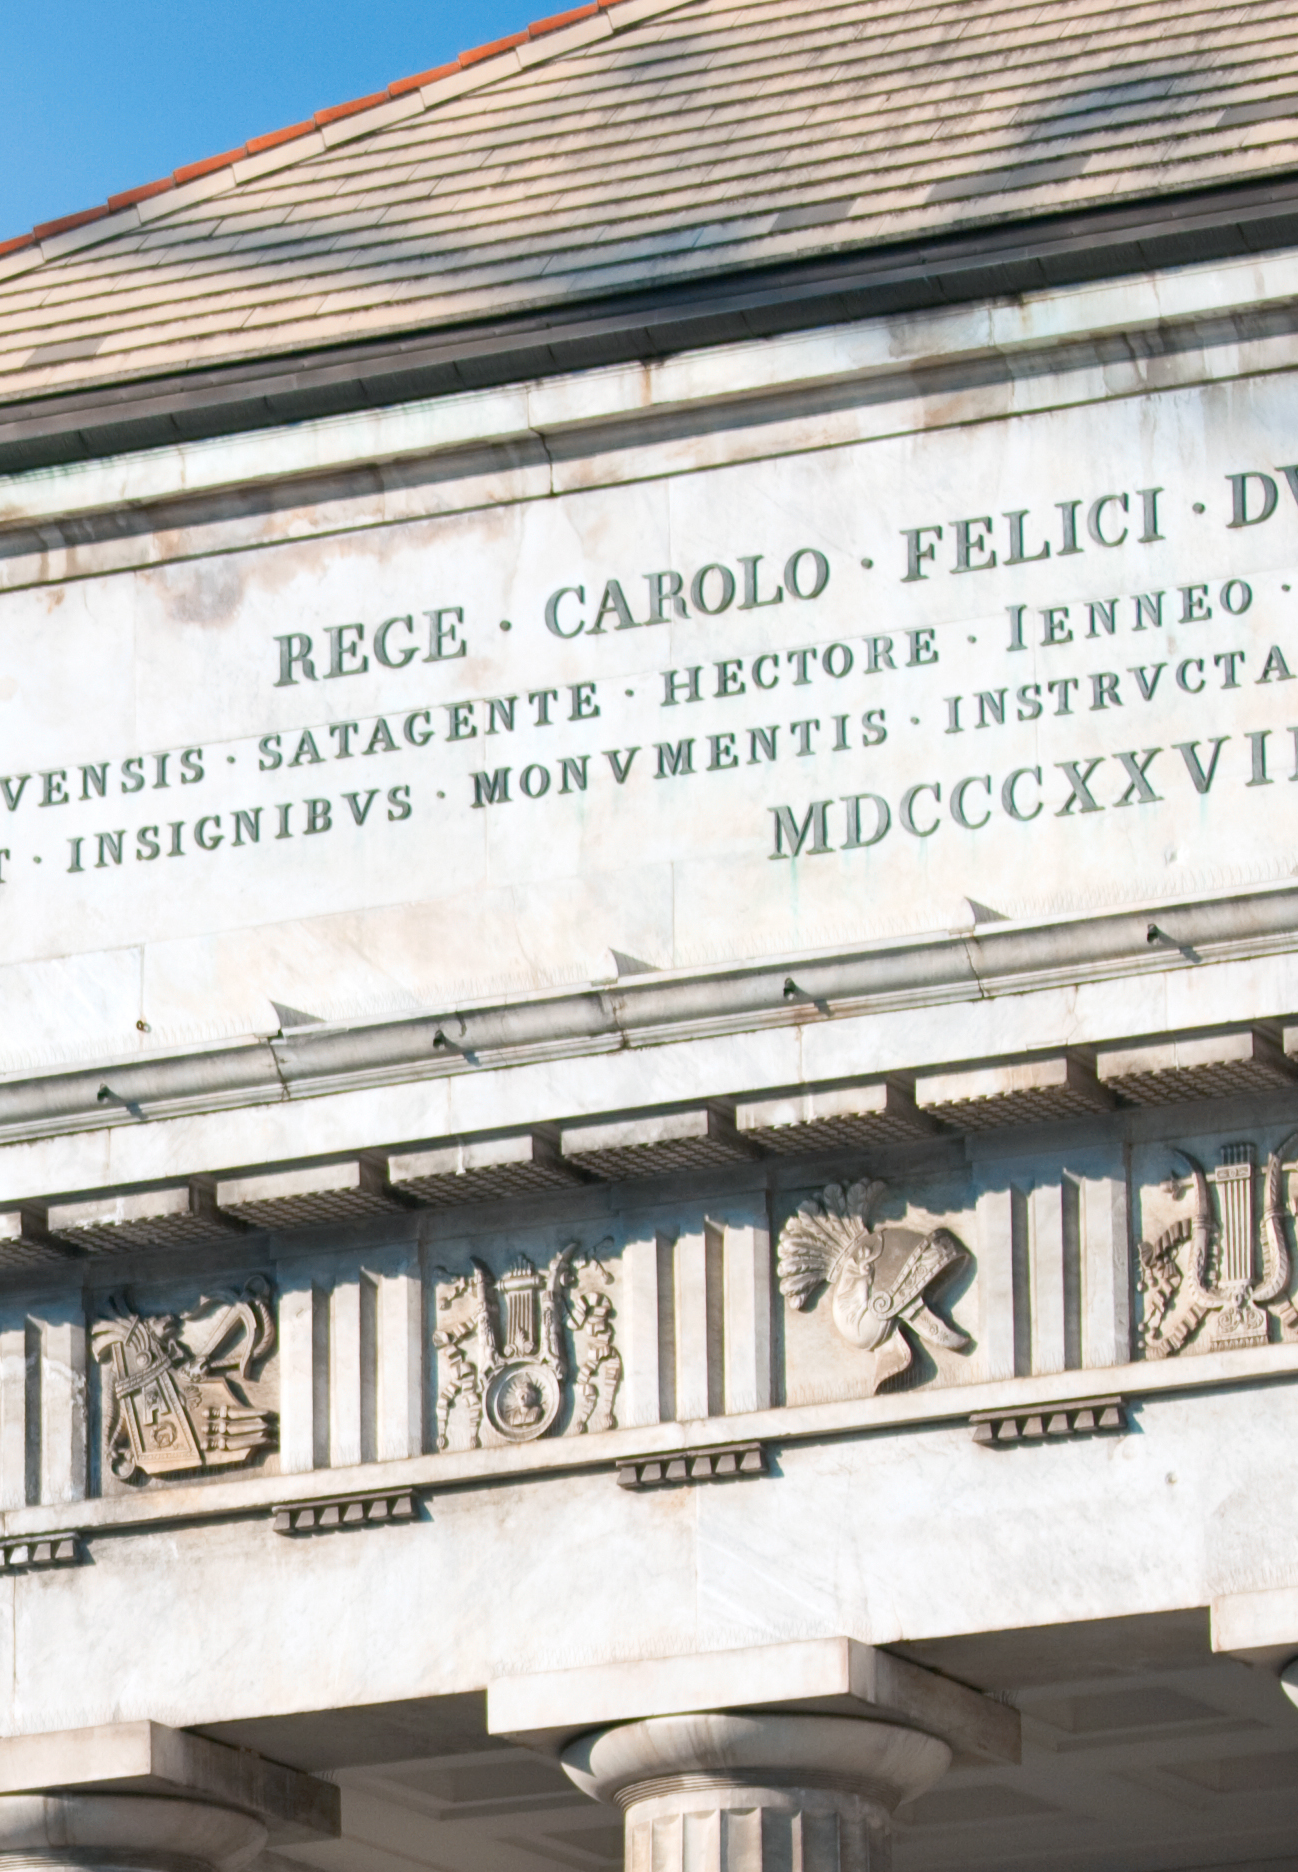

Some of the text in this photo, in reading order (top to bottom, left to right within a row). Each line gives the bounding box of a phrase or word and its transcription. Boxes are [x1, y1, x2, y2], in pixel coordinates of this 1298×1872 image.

[259, 682, 600, 771] SATAGENTE
[661, 628, 939, 706] HECTORE
[1007, 579, 1252, 652] IENNEO
[274, 607, 467, 687] REGE
[545, 548, 830, 639] CAROLO
[900, 487, 1165, 583] FELICI
[67, 785, 412, 873] INSIGNIBVS
[470, 709, 887, 809] MONVMENTIS
